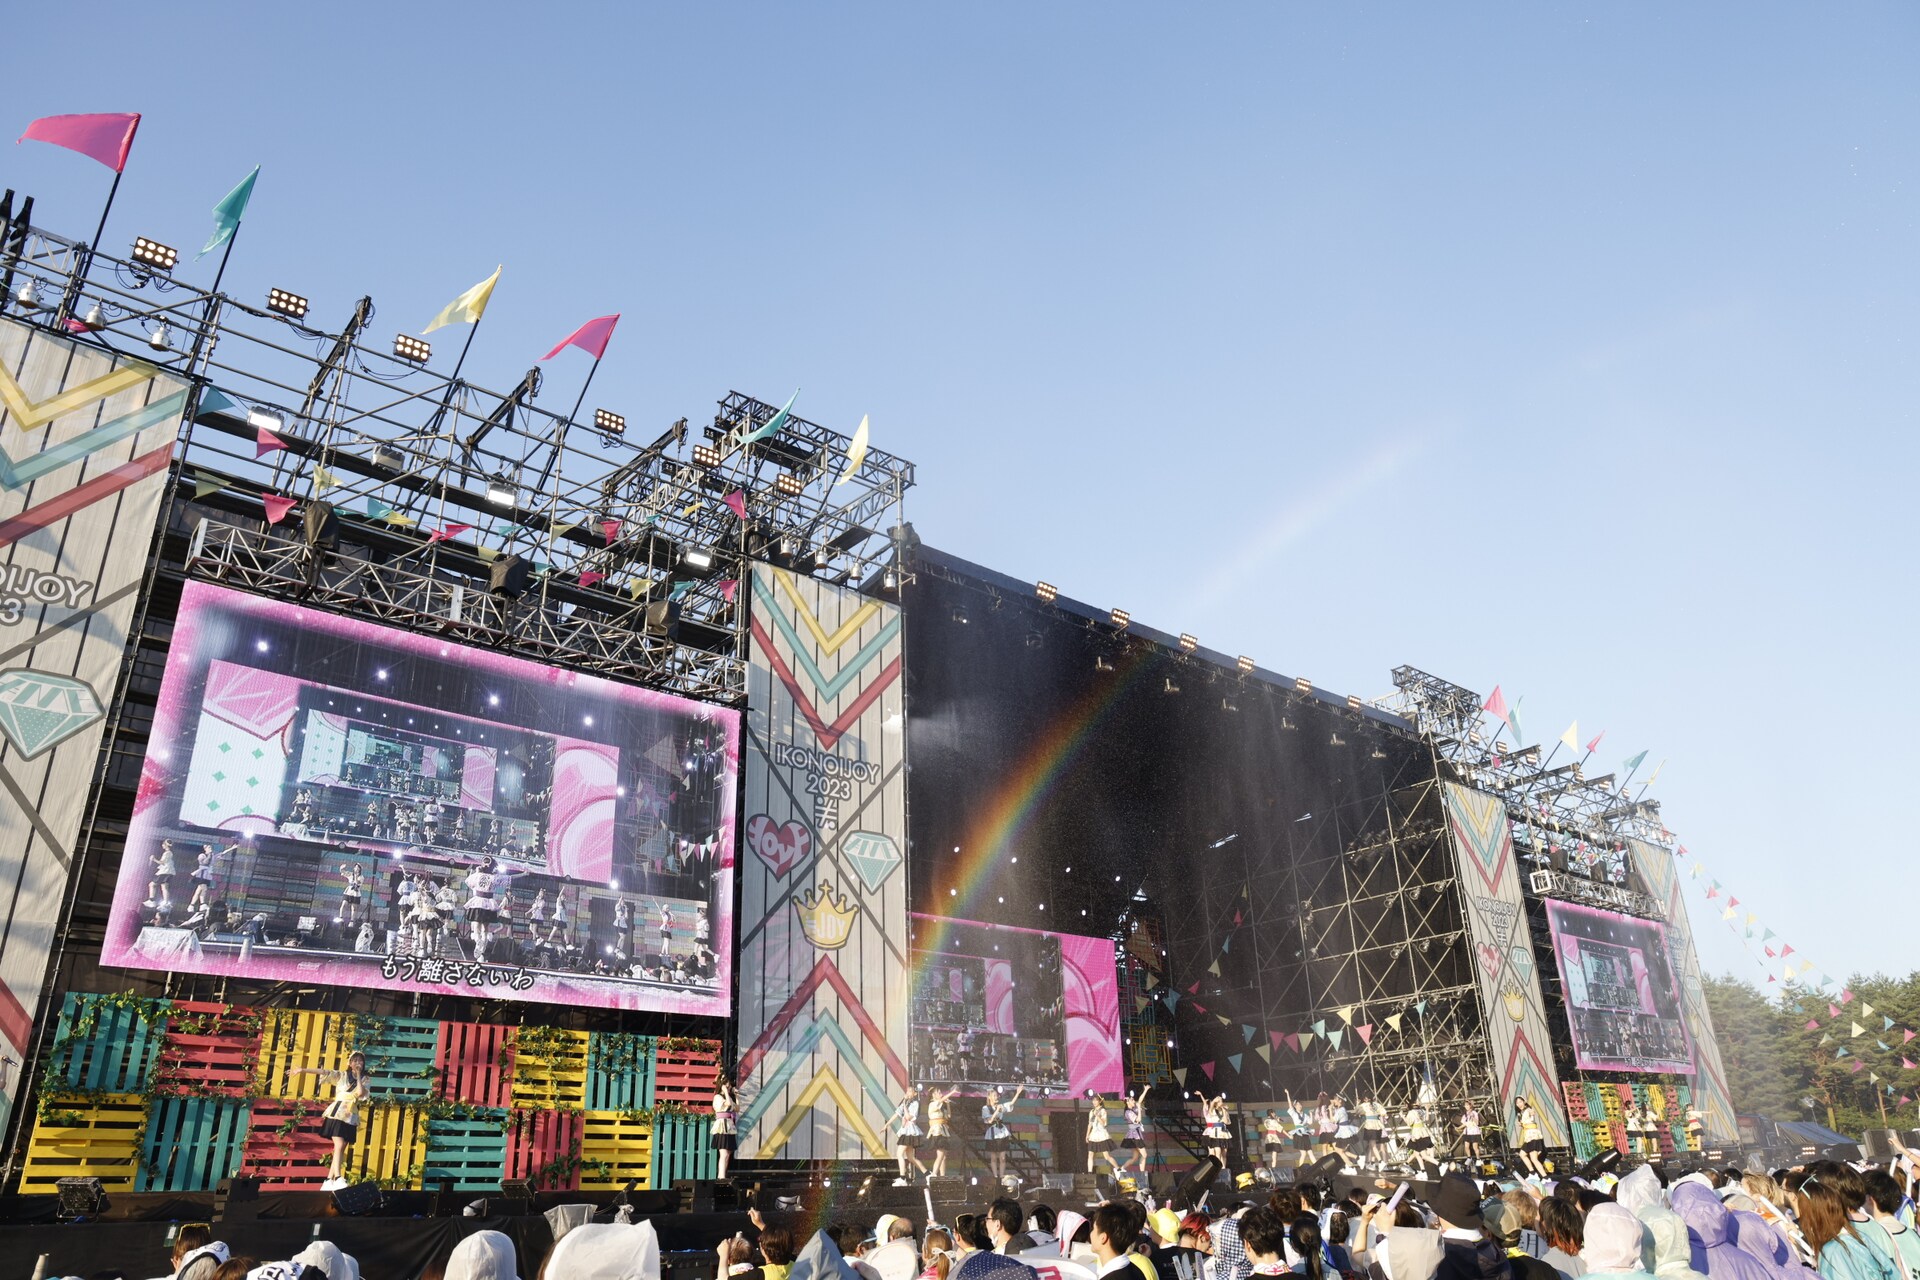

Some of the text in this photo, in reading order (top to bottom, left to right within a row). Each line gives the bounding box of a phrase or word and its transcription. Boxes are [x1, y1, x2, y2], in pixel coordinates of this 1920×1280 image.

[0, 564, 93, 608] IJOY
[0, 596, 25, 625] 3
[776, 743, 880, 784] IKONOIJOY
[805, 773, 851, 799] 2023
[382, 954, 534, 989] もう離さないわ
